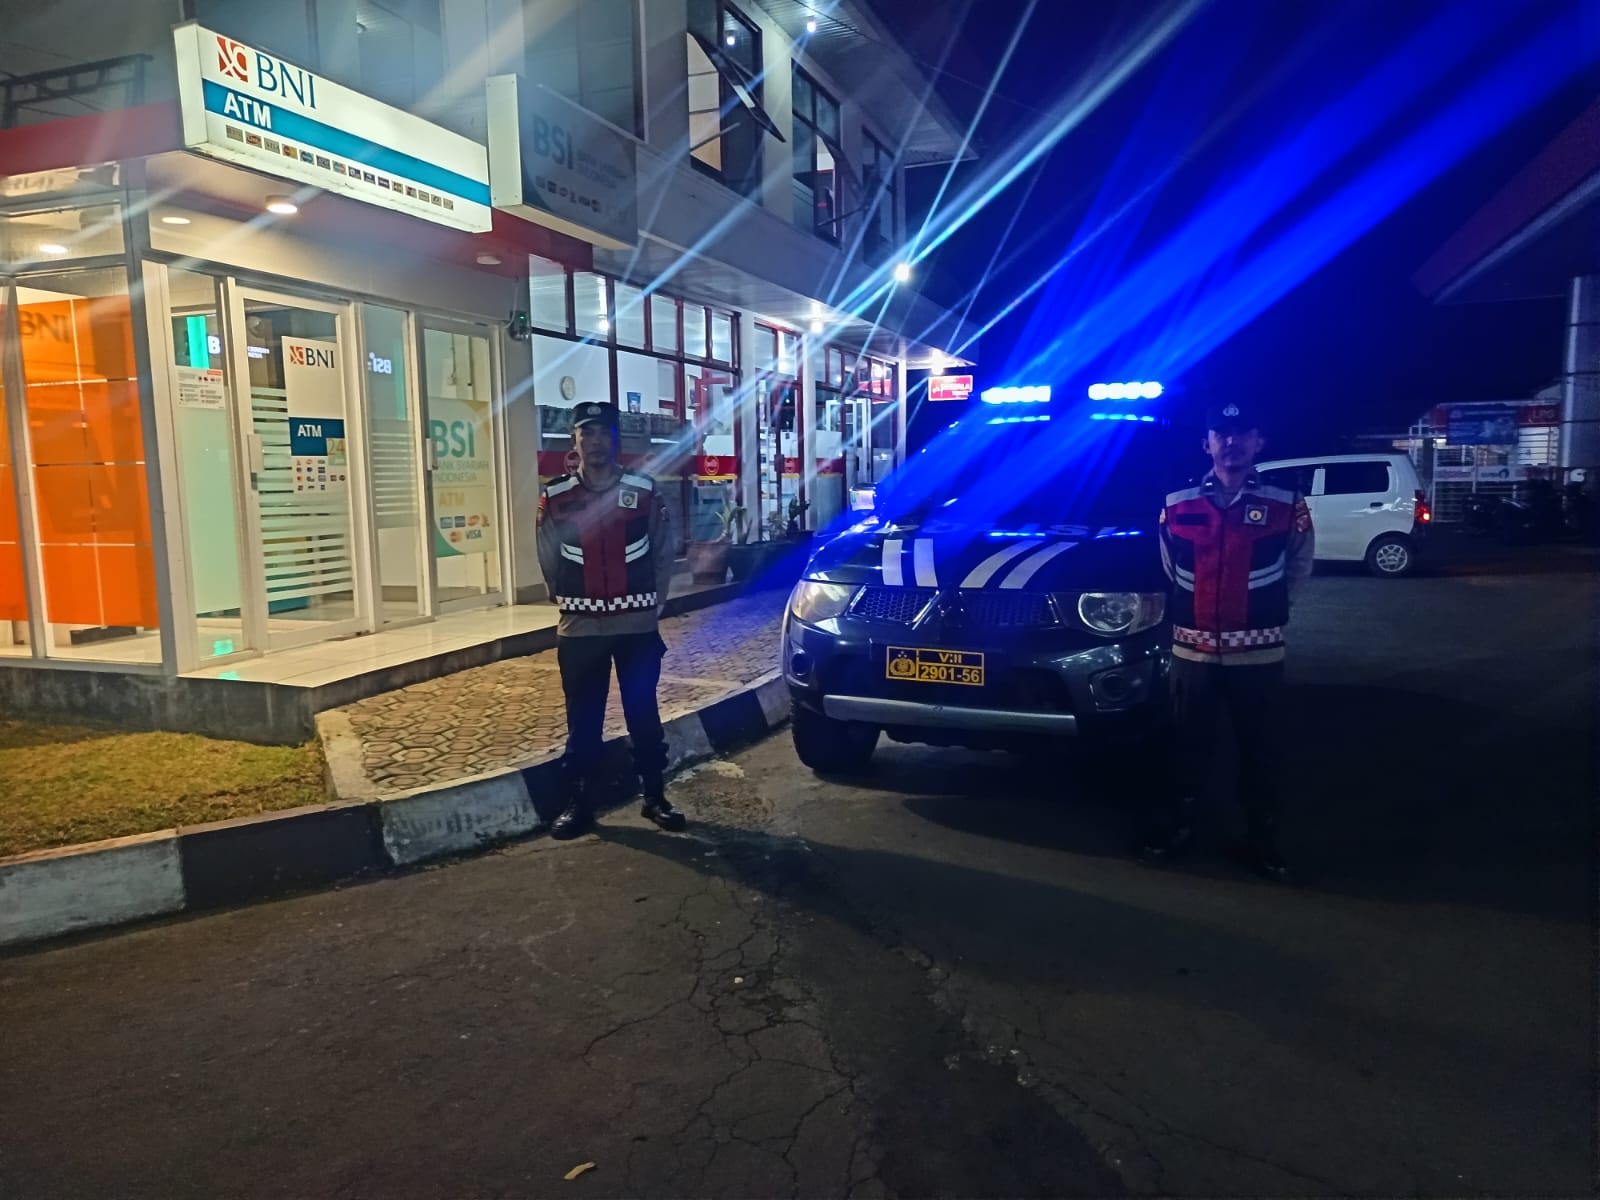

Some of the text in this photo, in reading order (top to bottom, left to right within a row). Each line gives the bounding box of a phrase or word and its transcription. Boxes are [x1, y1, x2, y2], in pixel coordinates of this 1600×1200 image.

[255, 51, 316, 109] BNI
[223, 91, 272, 129] ATM
[533, 114, 573, 170] BSI
[305, 347, 335, 368] BNI
[297, 424, 322, 437] ATM
[430, 419, 475, 458] BSI
[328, 438, 345, 455] 24
[920, 665, 980, 682] 2901-56
